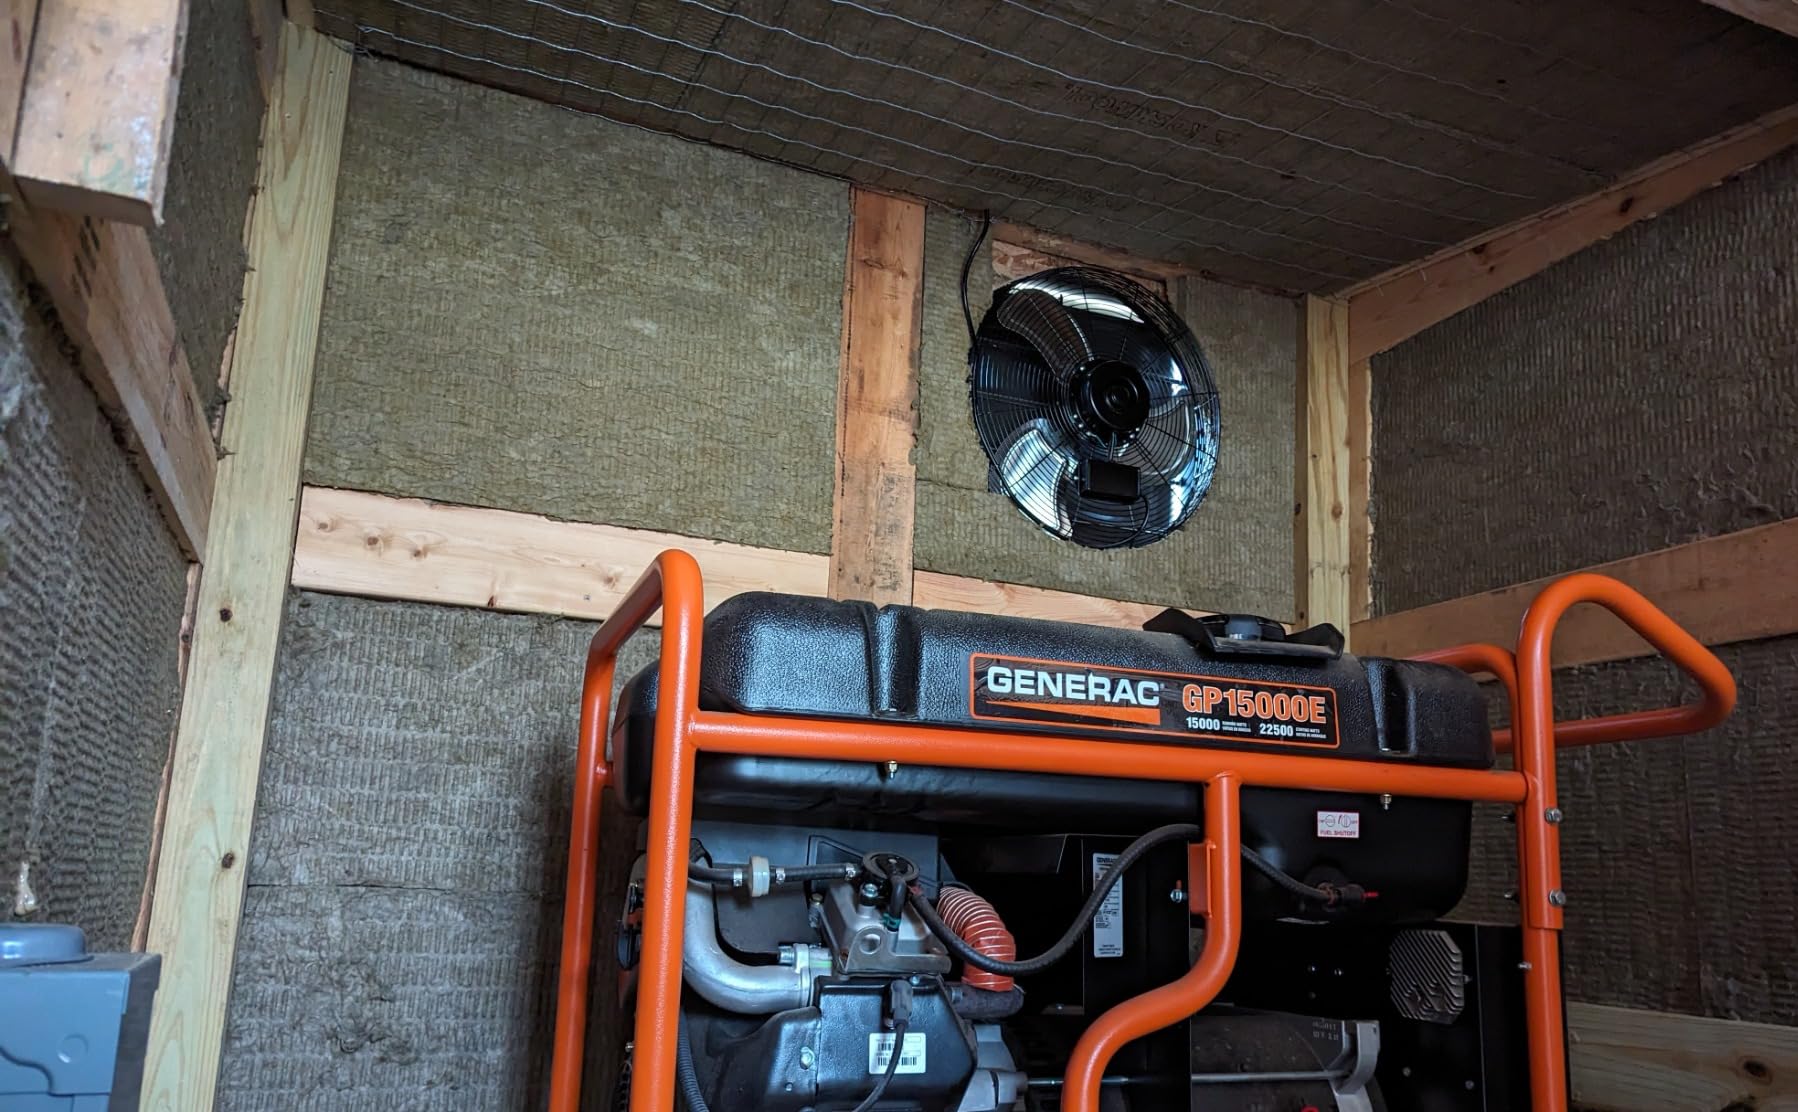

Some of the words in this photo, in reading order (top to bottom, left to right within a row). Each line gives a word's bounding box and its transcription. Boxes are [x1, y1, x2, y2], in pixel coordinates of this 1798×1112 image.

[987, 666, 1160, 706] GENERAC
[1182, 684, 1327, 724] GP15000E
[1186, 716, 1221, 731] 15000
[1259, 723, 1294, 737] 22500
